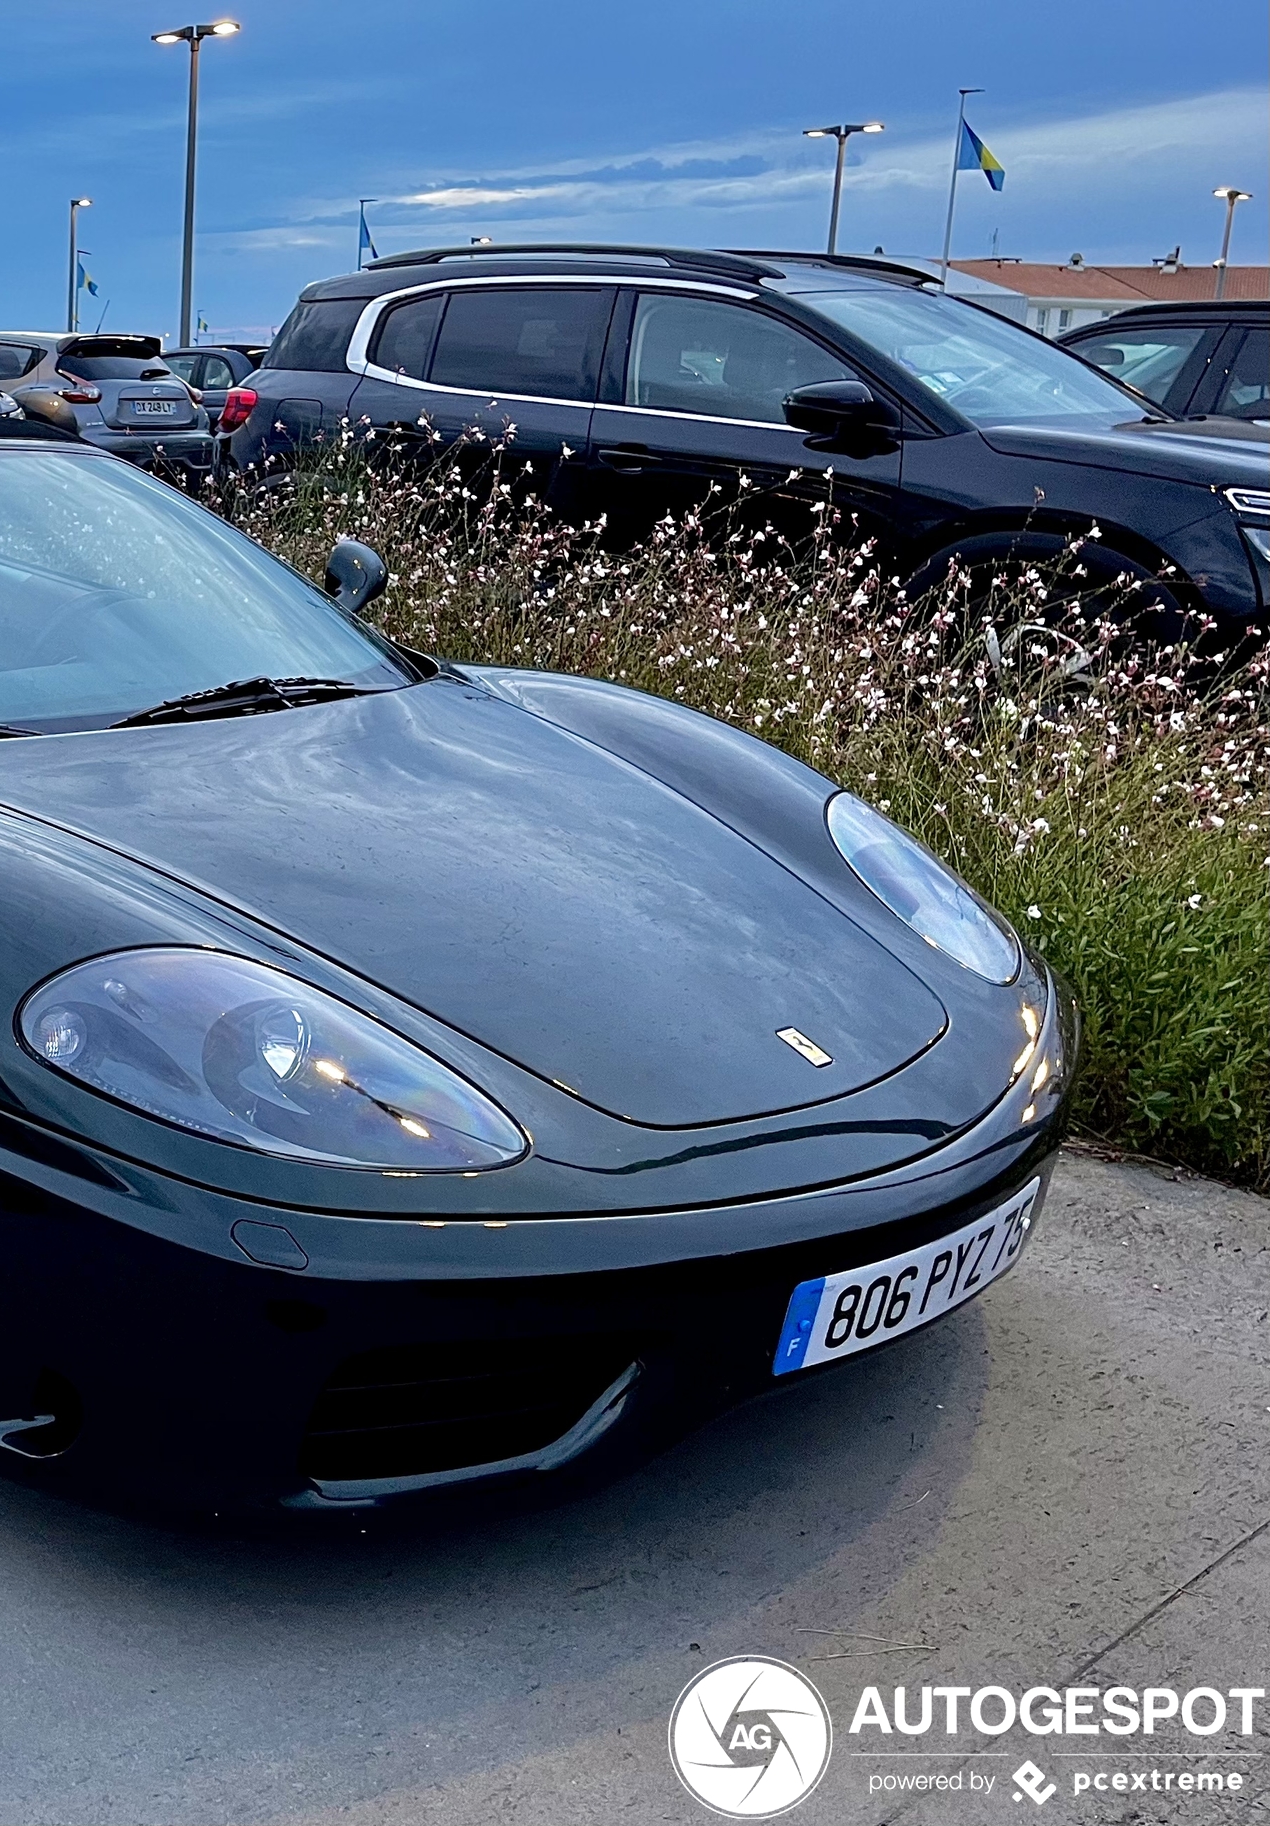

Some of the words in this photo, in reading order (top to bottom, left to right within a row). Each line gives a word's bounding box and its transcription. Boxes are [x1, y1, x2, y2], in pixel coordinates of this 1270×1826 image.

[824, 1266, 920, 1348] 806
[918, 1226, 995, 1315] PYZ
[991, 1196, 1034, 1270] 75
[786, 1337, 801, 1357] F
